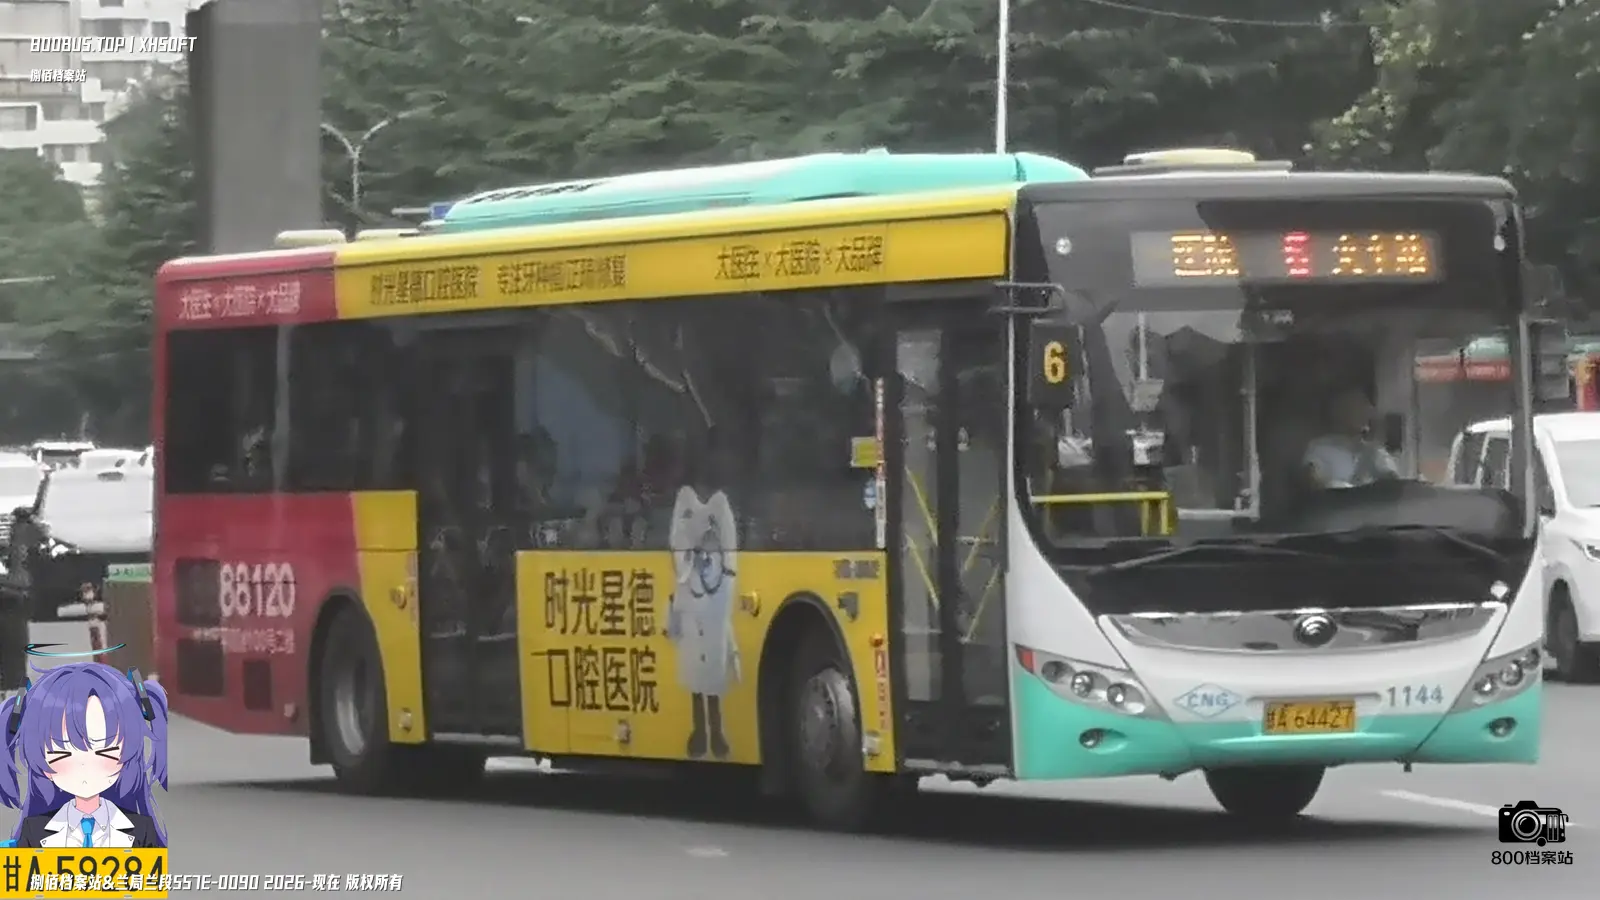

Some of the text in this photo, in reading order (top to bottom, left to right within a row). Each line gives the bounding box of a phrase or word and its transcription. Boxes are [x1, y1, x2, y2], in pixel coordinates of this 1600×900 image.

[1043, 340, 1067, 384] 6
[544, 567, 656, 638] 时光星德
[547, 644, 660, 713] 口腔医院
[1187, 691, 1230, 708] CNG
[1386, 684, 1445, 708] 1144
